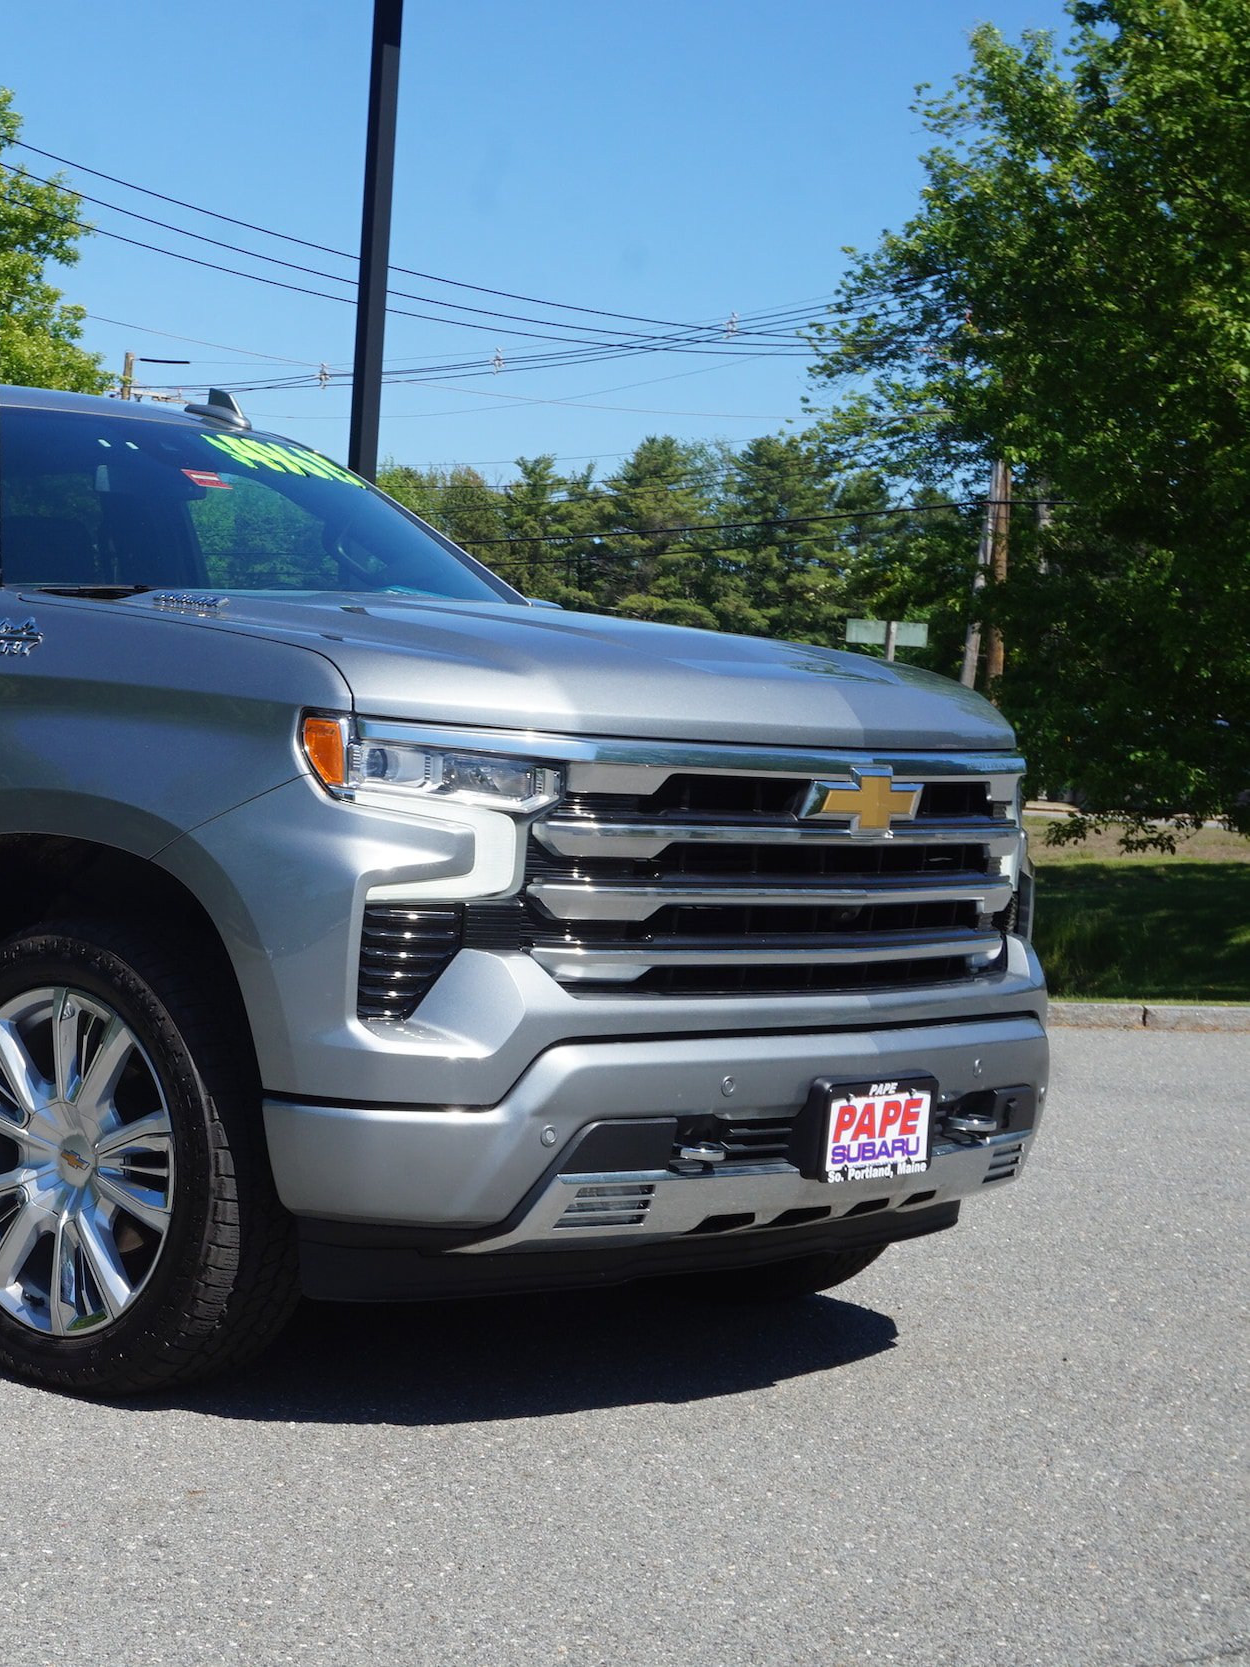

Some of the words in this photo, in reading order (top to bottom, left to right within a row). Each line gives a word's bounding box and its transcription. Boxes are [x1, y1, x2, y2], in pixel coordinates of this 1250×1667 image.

[869, 1082, 898, 1096] PAPE
[832, 1098, 923, 1143] PAPE
[831, 1136, 920, 1164] SUBARU
[827, 1170, 845, 1183] So.
[847, 1164, 894, 1181] Portland,
[897, 1161, 927, 1175] Maine
